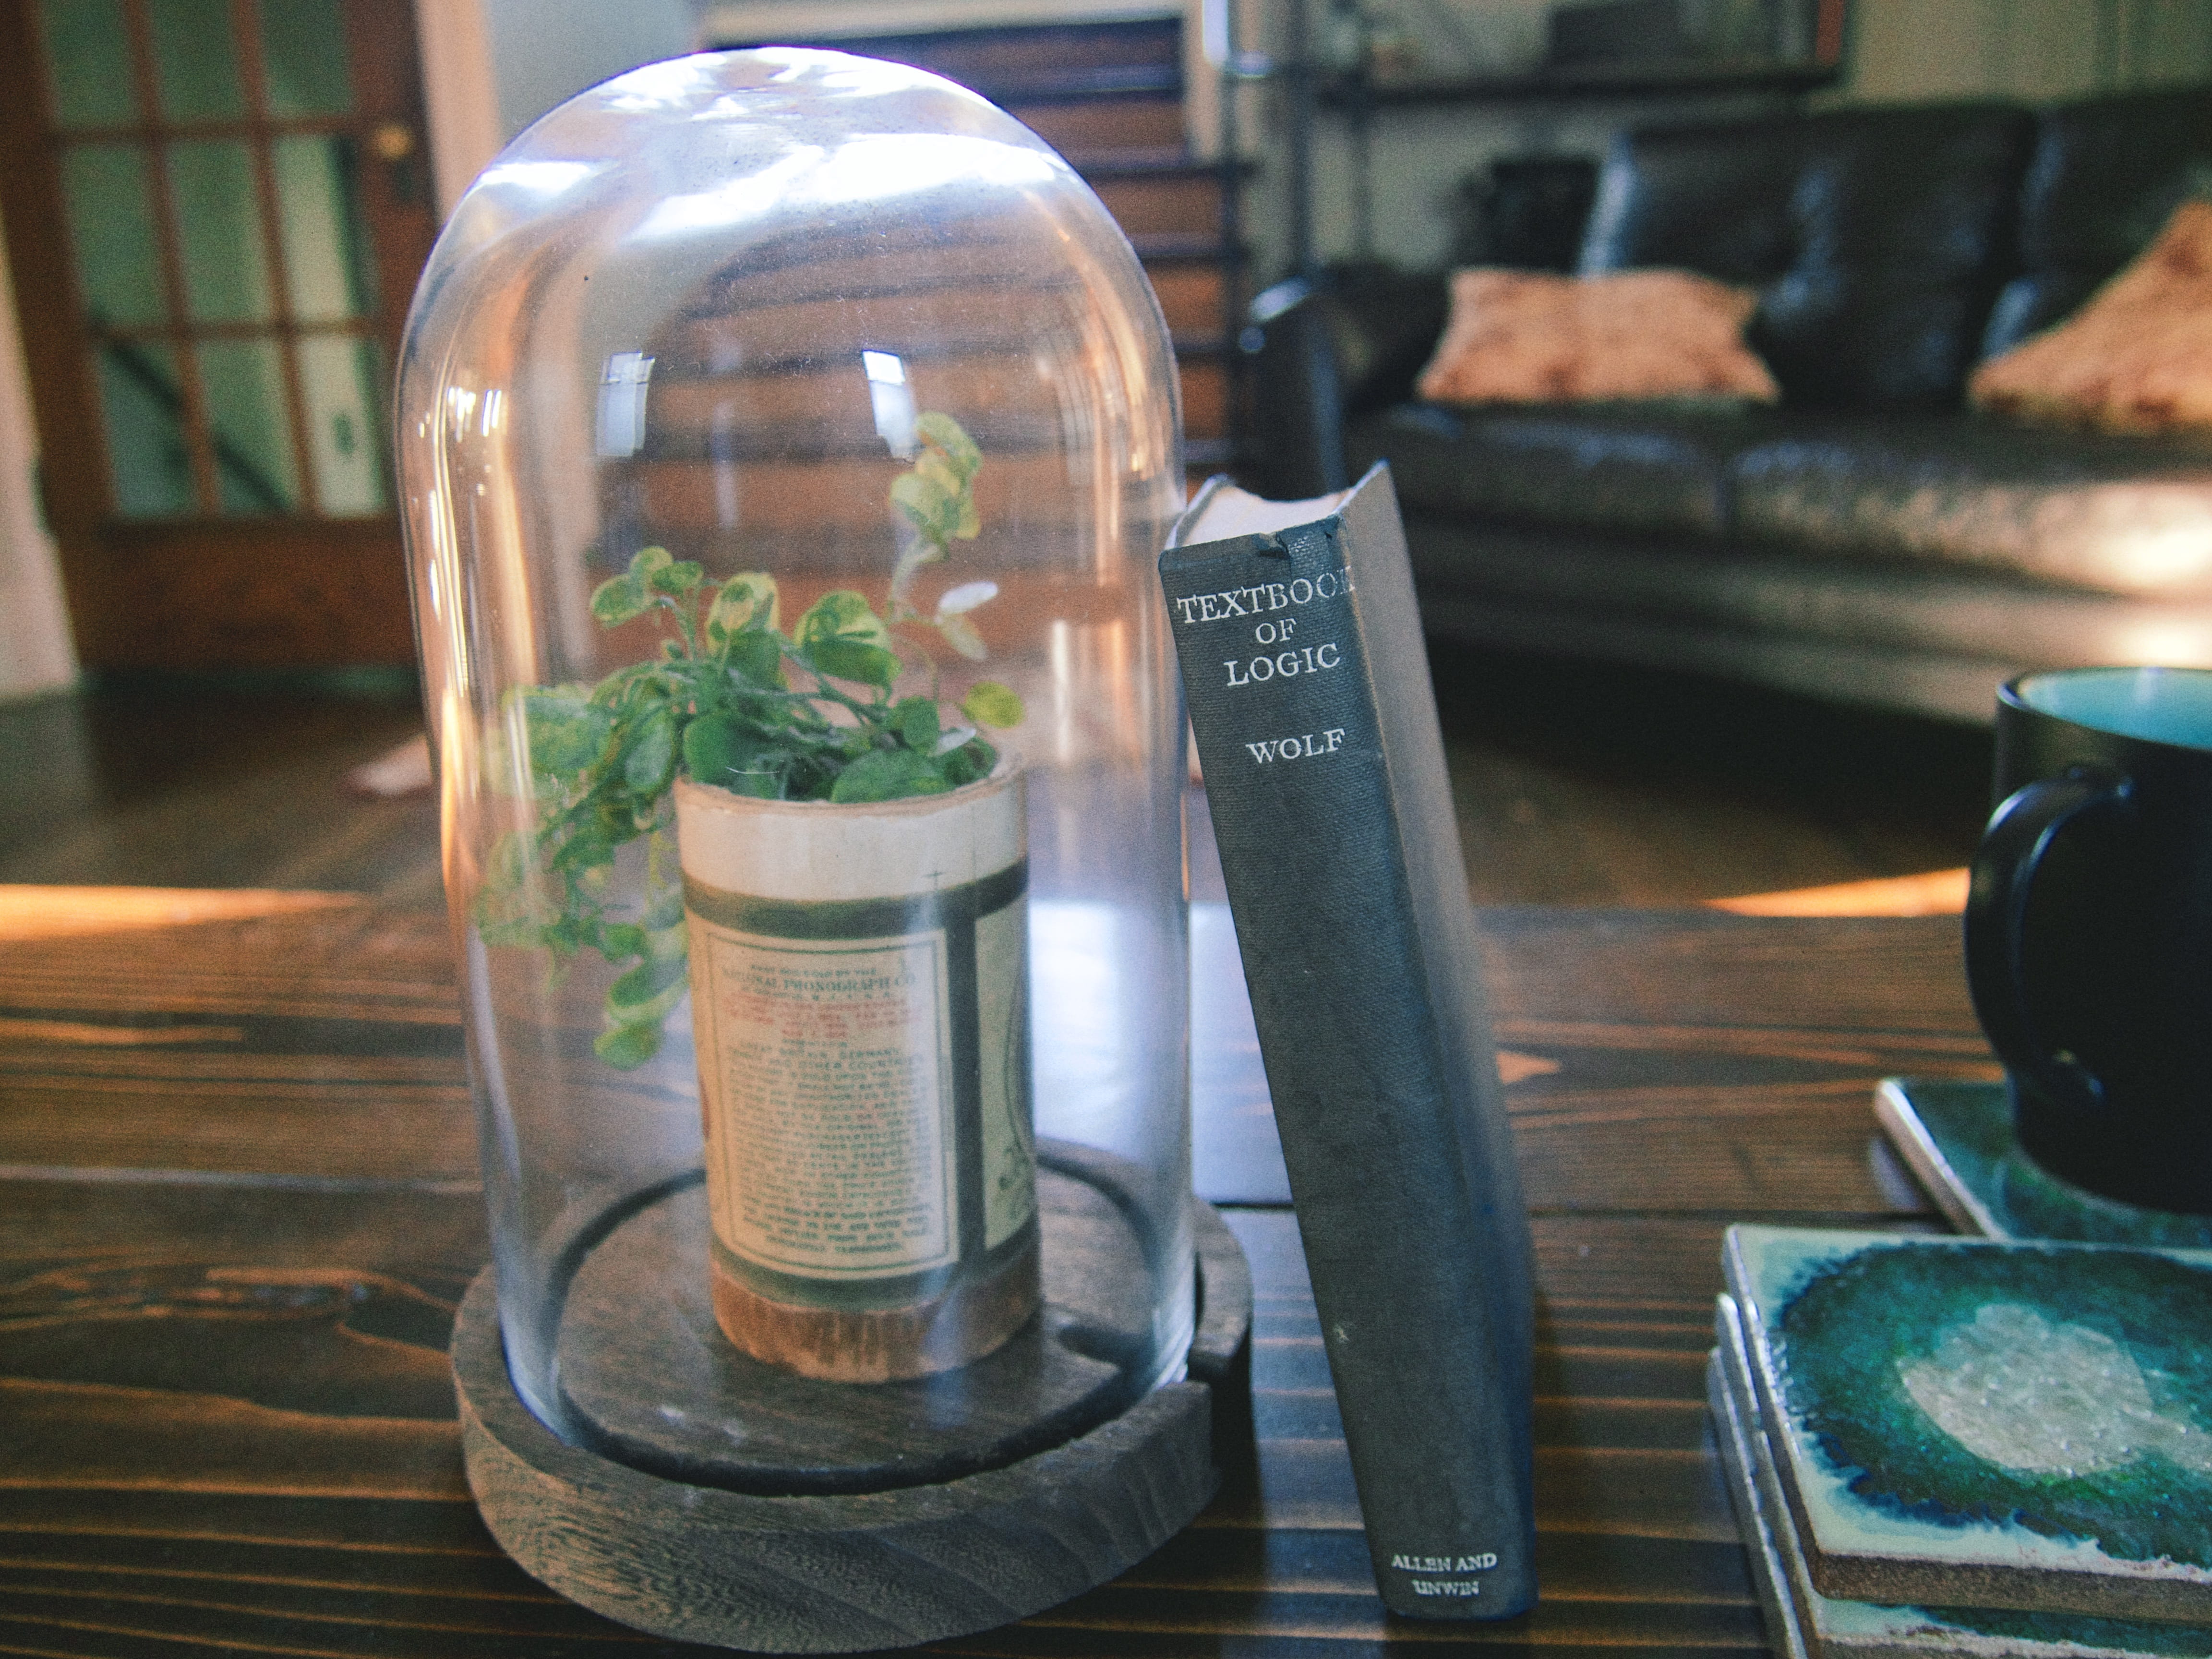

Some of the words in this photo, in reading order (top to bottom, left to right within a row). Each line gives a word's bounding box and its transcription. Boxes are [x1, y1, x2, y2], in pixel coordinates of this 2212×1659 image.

[1255, 618, 1297, 644] OF
[1224, 643, 1341, 686] LOGIC
[1246, 728, 1346, 764] WOLF
[1392, 1554, 1451, 1572] ALLEN
[1455, 1552, 1497, 1572] AND
[1412, 1579, 1479, 1596] UNWIN
